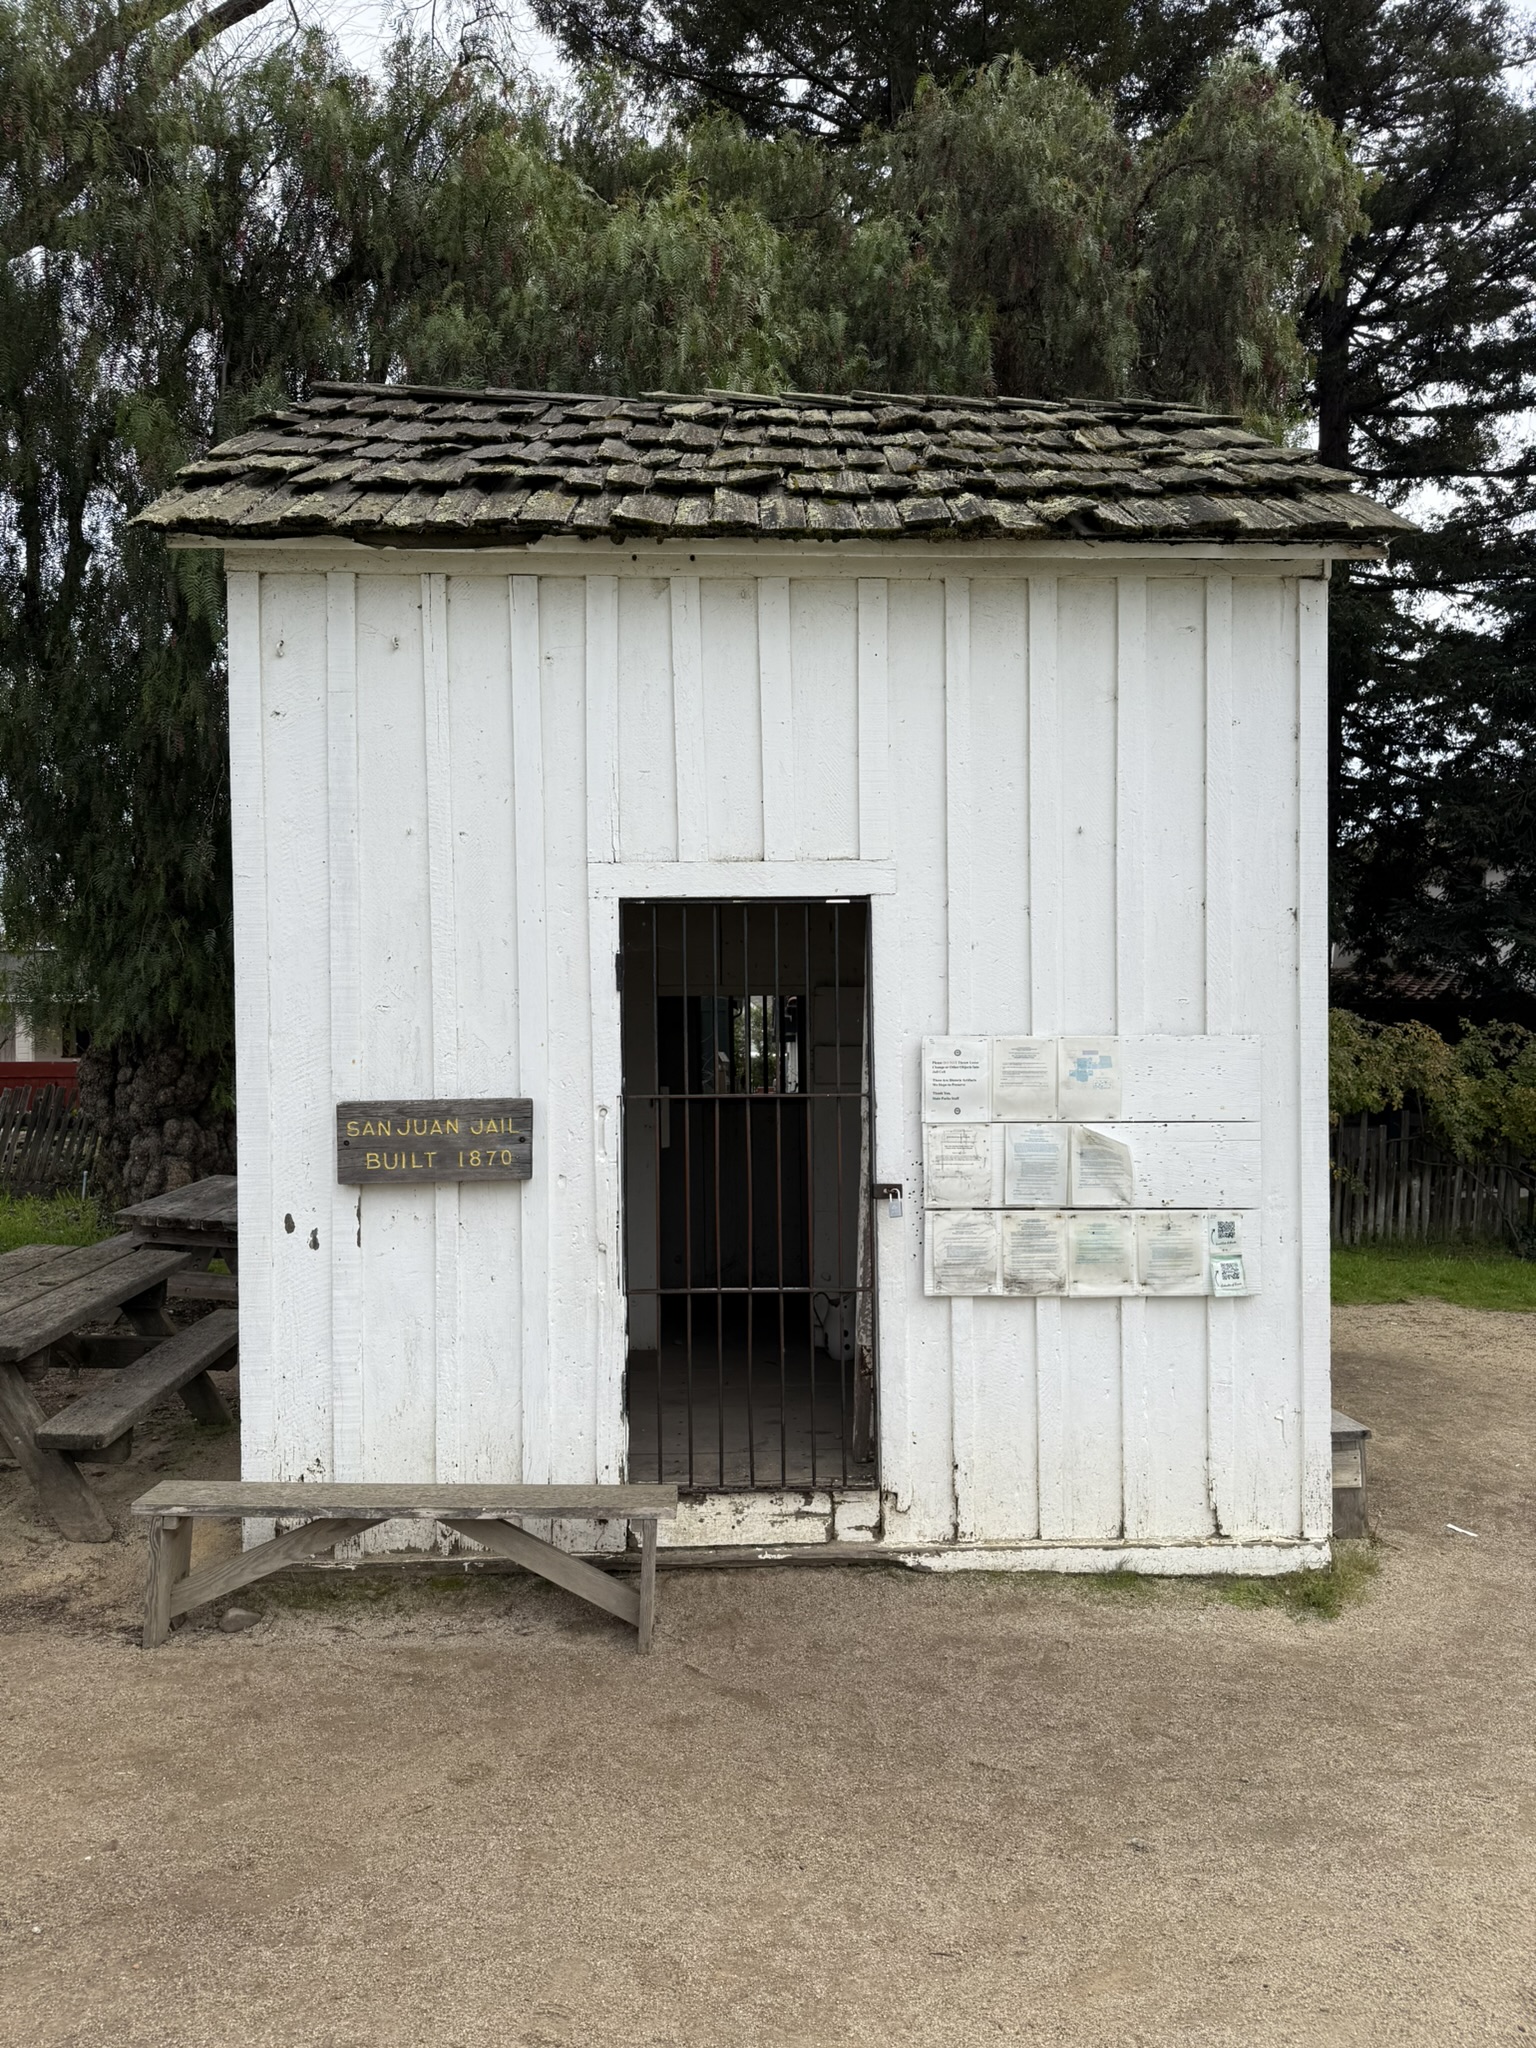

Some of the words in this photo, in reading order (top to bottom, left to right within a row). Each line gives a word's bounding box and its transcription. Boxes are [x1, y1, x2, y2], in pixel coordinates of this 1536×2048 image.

[346, 1120, 391, 1137] SAN
[396, 1118, 459, 1136] JUAN
[470, 1118, 520, 1135] JAIL
[366, 1152, 438, 1170] BUILT
[458, 1150, 512, 1168] 1870
